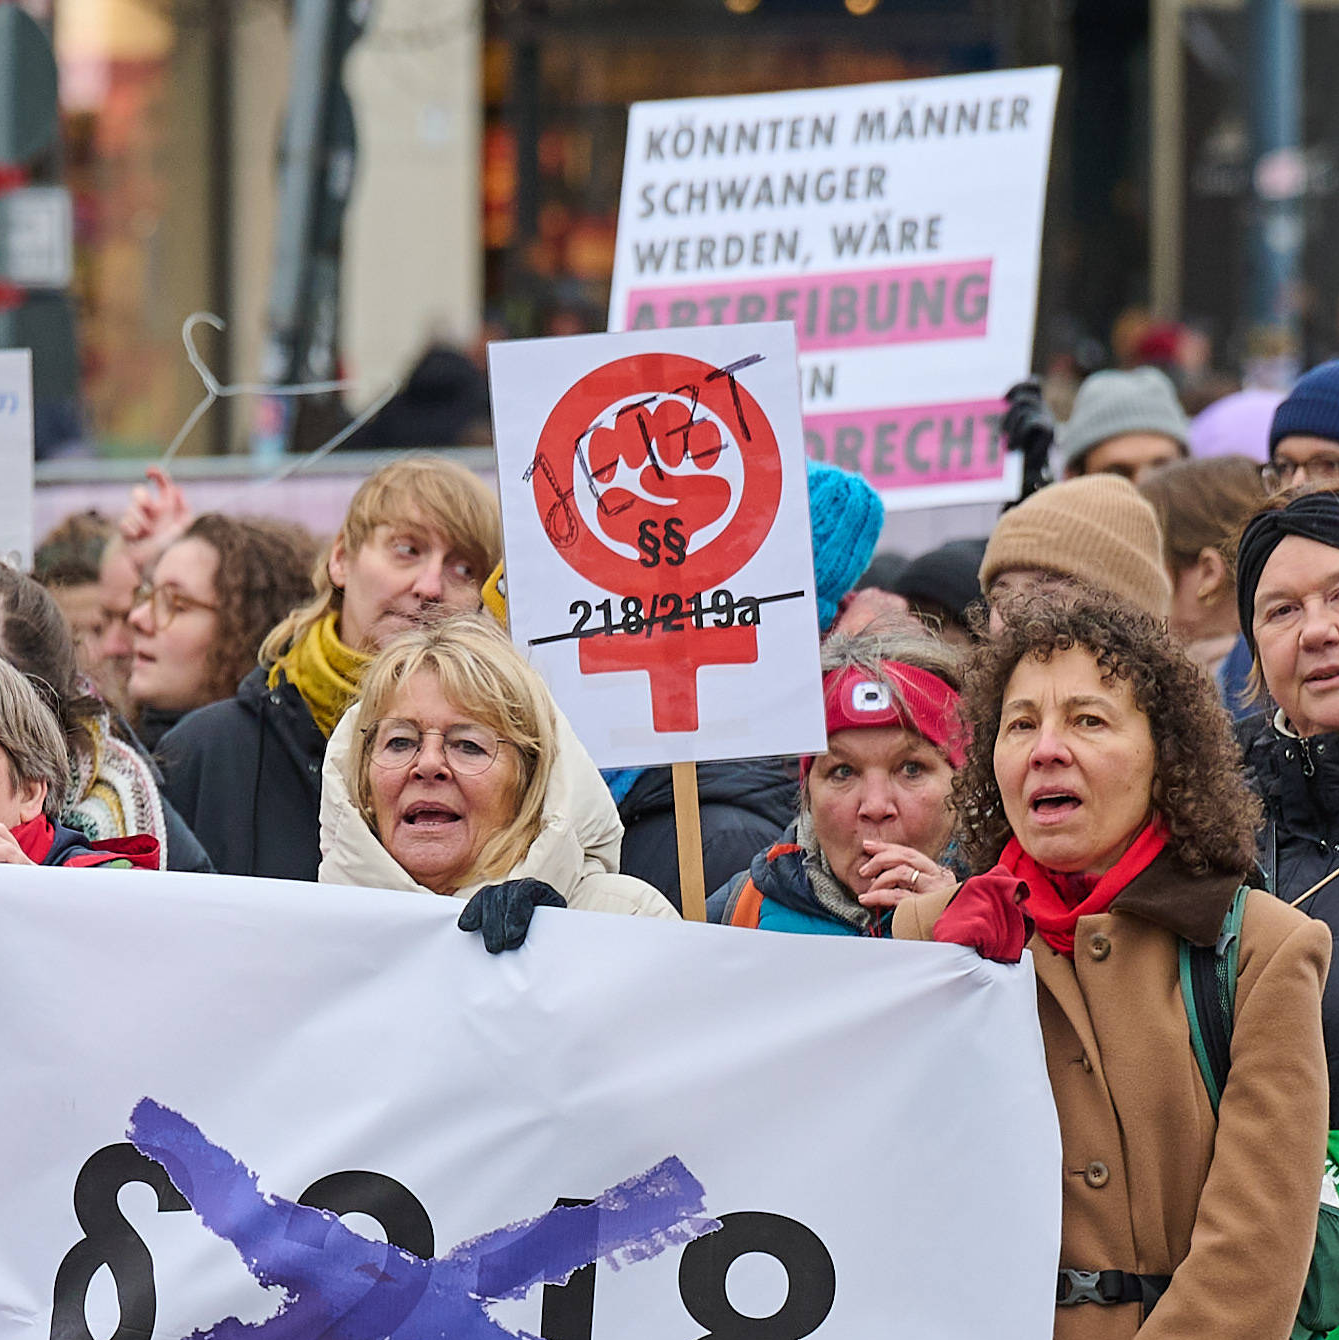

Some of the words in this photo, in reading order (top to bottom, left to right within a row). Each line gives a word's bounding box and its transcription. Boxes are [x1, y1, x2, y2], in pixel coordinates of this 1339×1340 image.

[645, 112, 838, 162] KÖNNTEN
[853, 94, 1032, 146] MÄNNER
[638, 166, 888, 219] SCHWANGER
[633, 229, 812, 275] WERDEN,
[830, 211, 945, 260] WÄRE
